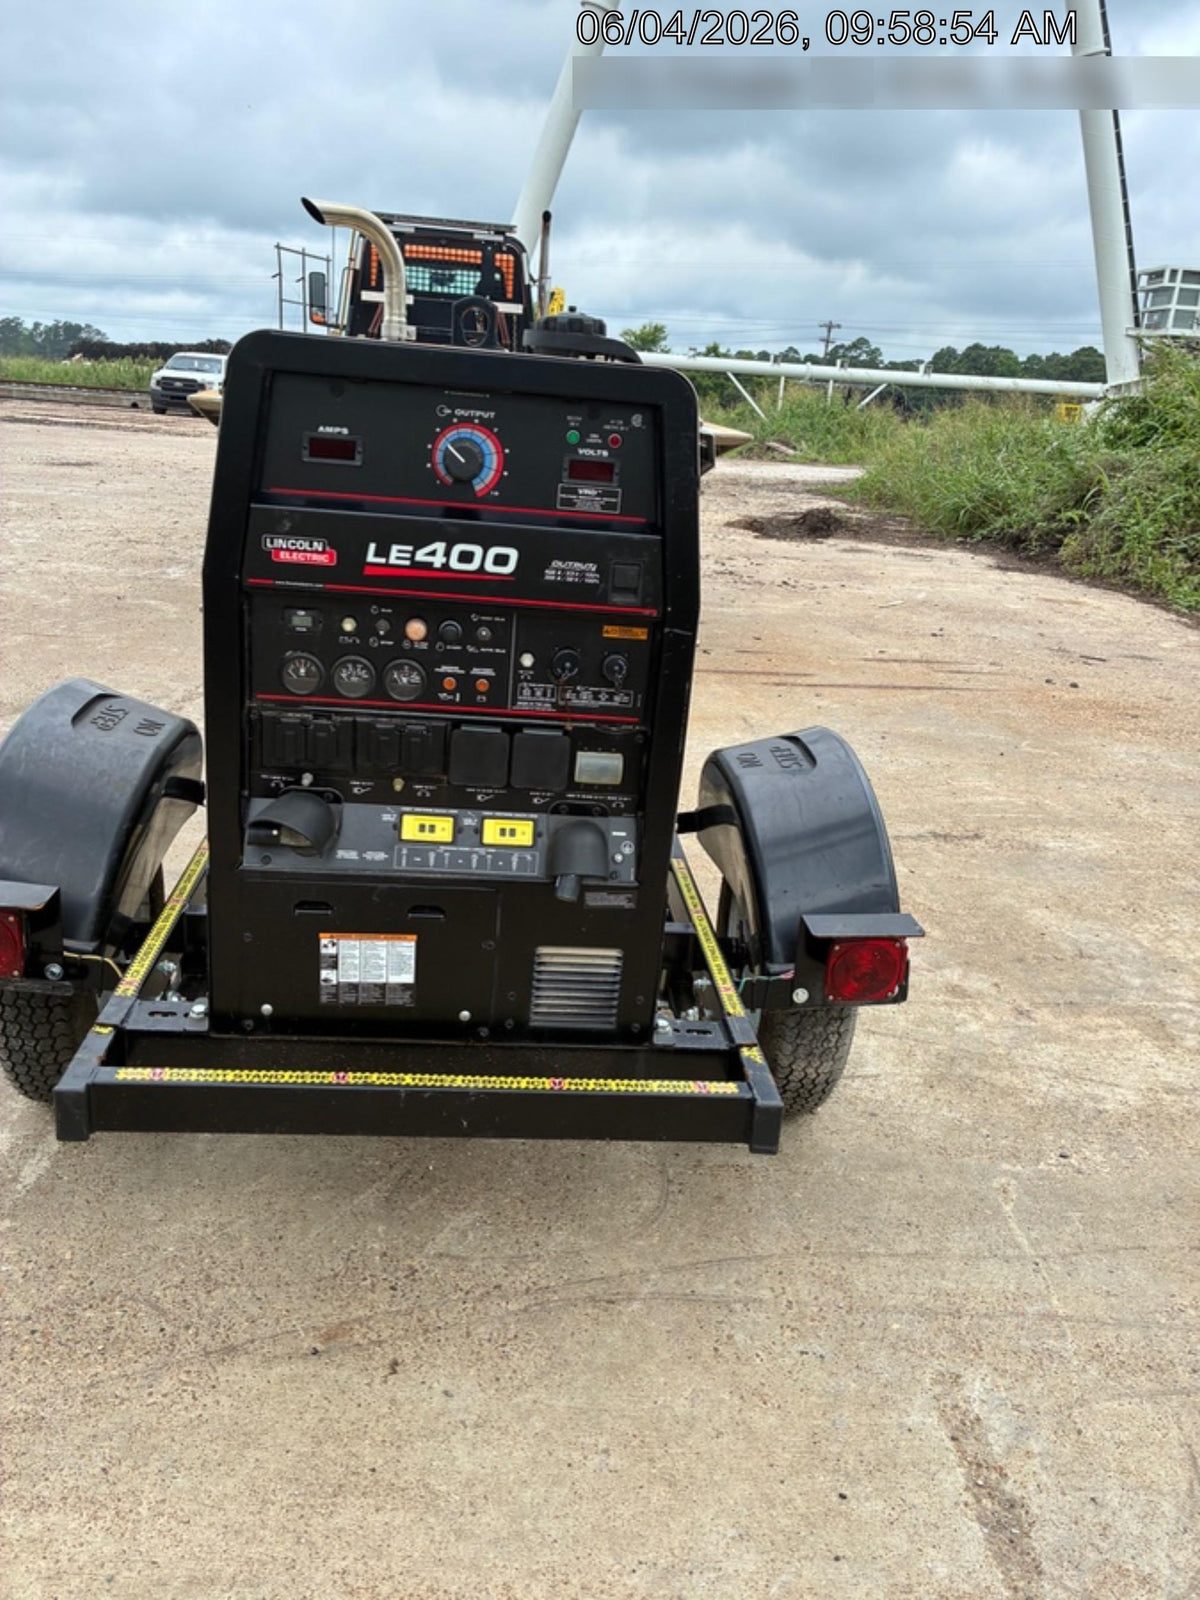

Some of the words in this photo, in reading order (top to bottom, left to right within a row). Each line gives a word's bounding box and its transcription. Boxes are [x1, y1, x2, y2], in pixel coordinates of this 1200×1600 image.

[454, 408, 496, 419] OUTPUT
[318, 425, 349, 435] AMPS
[577, 447, 609, 458] VOLTS
[265, 538, 325, 552] LINCOLN
[279, 550, 330, 563] ELECTRIC
[366, 541, 519, 575] LE400
[169, 1071, 194, 1079] DO
[196, 1071, 229, 1080] NOT
[233, 1072, 286, 1080] STAND
